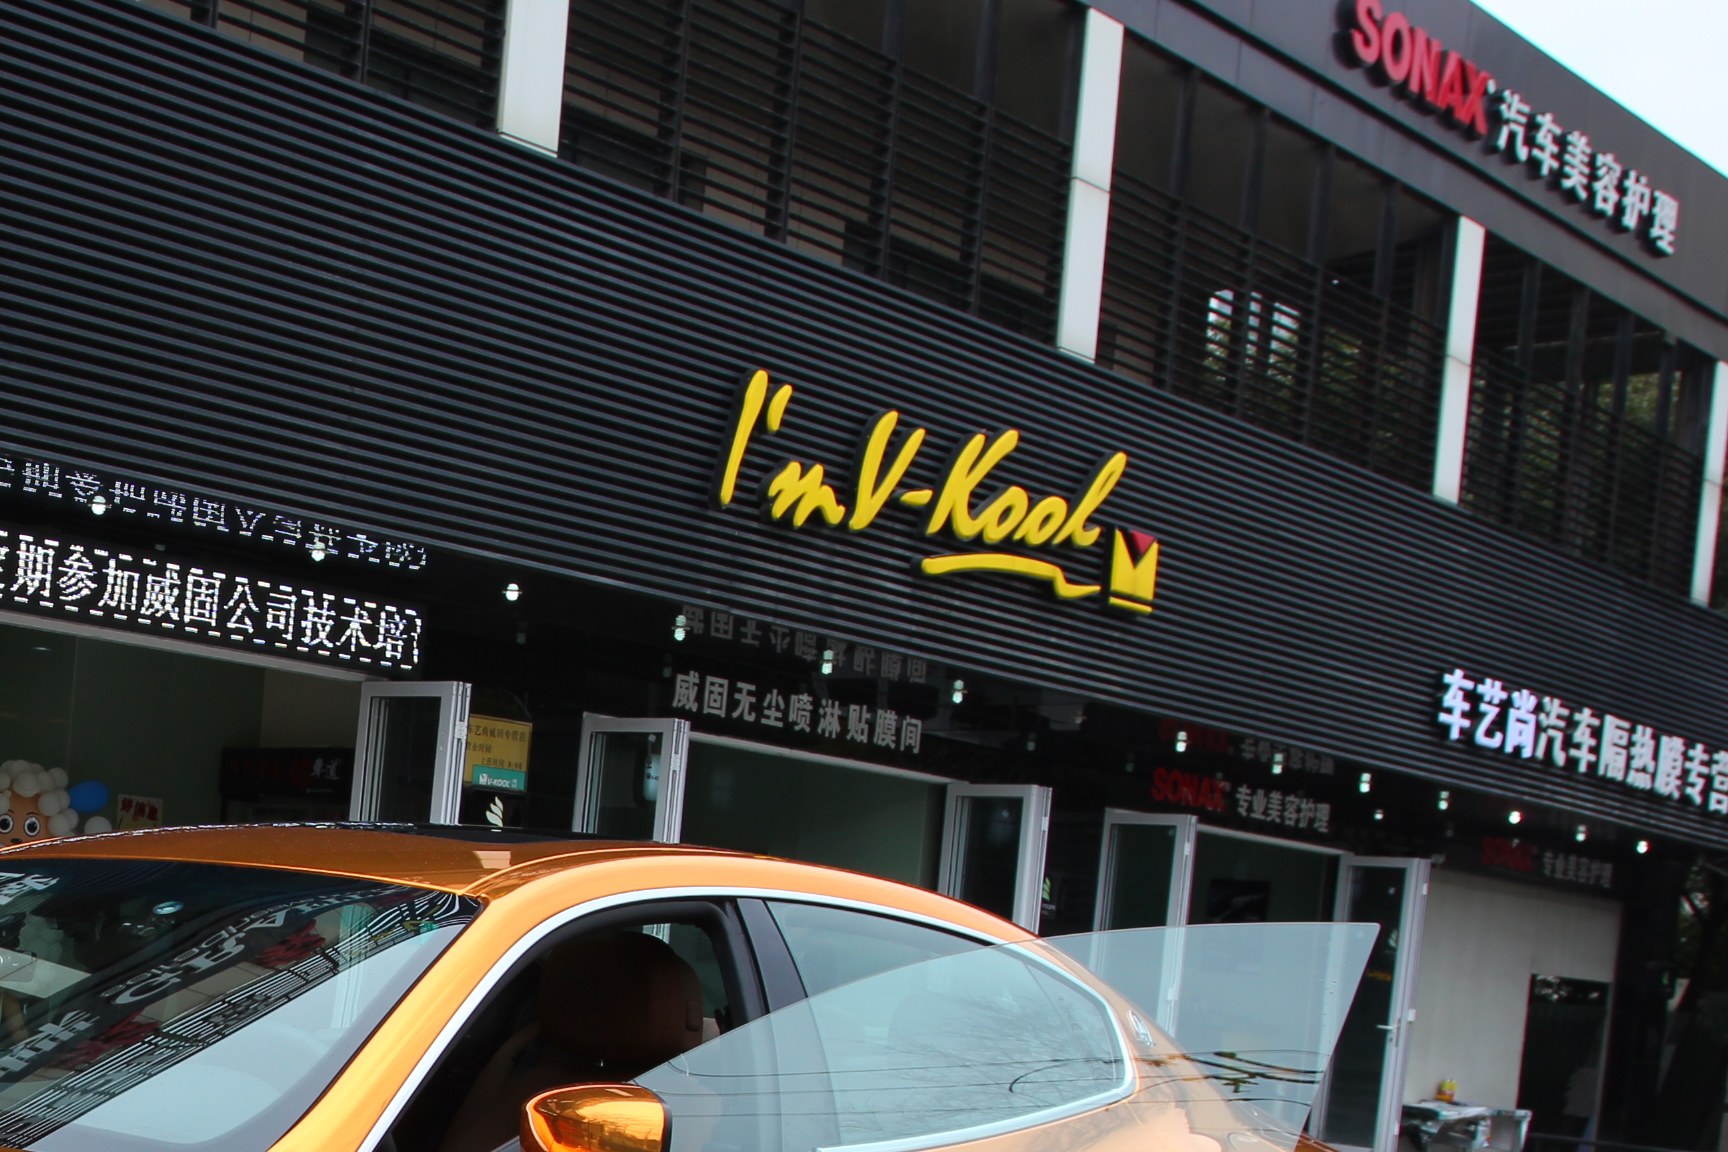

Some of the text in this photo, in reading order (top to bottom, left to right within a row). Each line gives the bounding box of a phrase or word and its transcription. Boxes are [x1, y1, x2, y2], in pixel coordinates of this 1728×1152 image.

[1350, 0, 1490, 136] SONAX
[1497, 89, 1679, 255] 汽车美容护理
[718, 368, 1127, 548] I'm V-Kool
[671, 670, 923, 755] 威固无尘喷淋贴膜间
[1151, 766, 1332, 833] SONAX 专业美容护理
